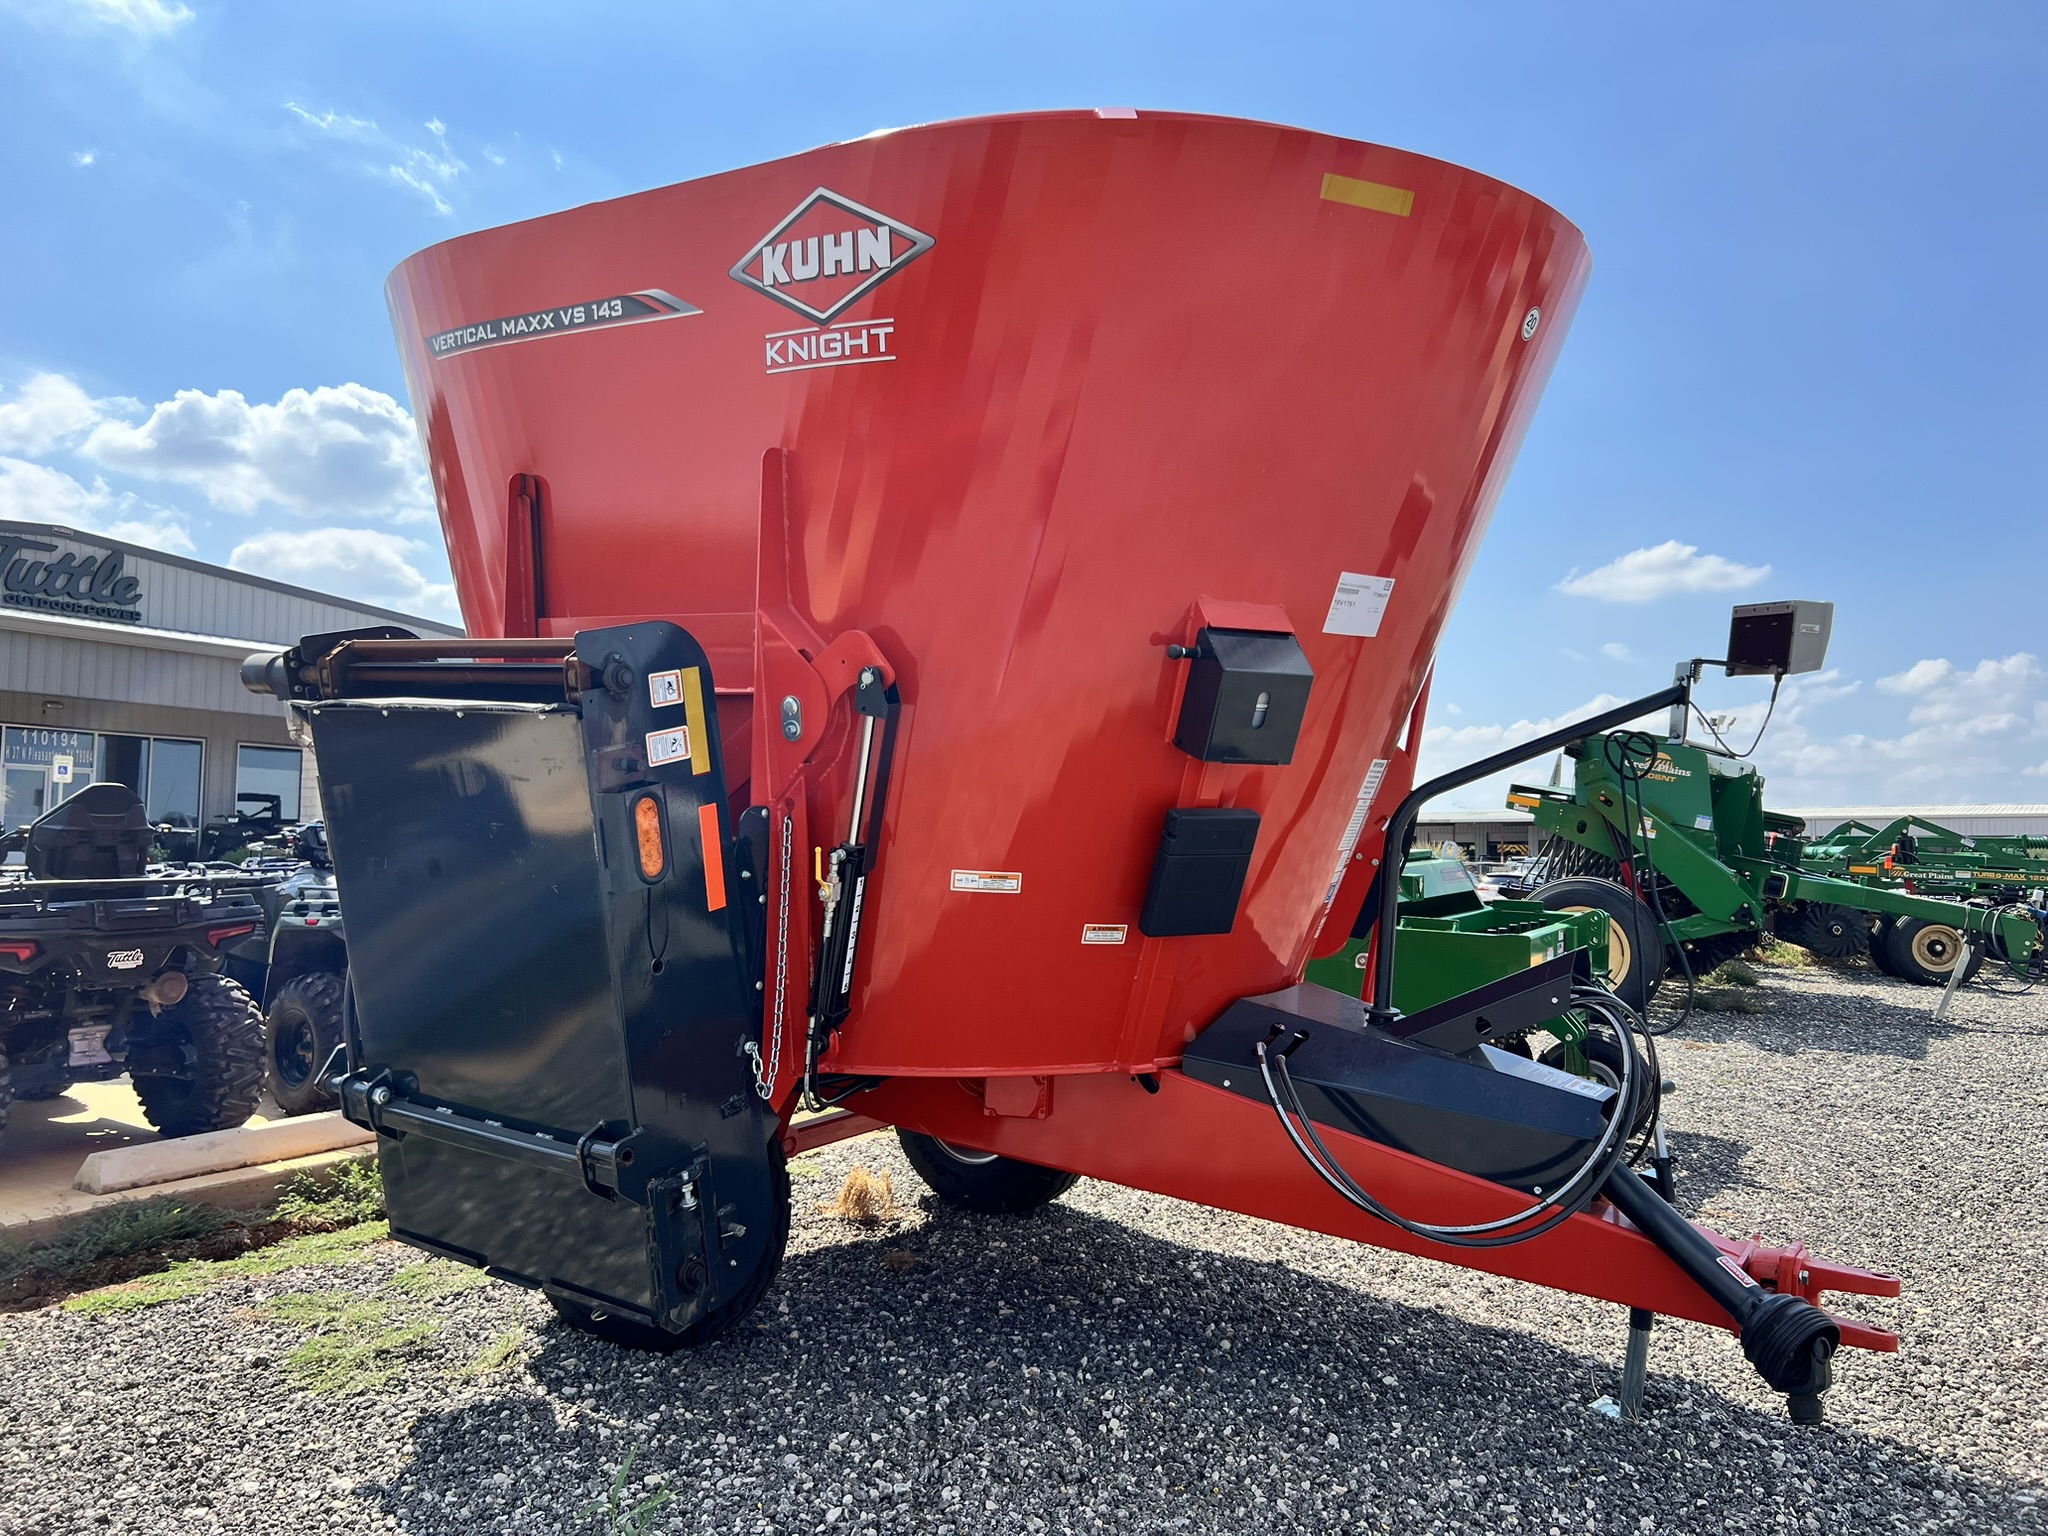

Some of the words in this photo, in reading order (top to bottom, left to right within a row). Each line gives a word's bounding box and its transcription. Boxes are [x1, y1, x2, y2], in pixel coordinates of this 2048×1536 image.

[762, 226, 892, 286] KUHN
[432, 324, 497, 352] VERTICAL
[501, 312, 555, 336] MAXX
[560, 306, 586, 326] VS
[591, 299, 623, 321] 143
[1526, 313, 1538, 330] 20
[765, 326, 894, 366] KNIGHT
[0, 535, 143, 606] Tuttle
[4, 593, 85, 614] OUTDOOR
[85, 604, 142, 621] POWER
[21, 728, 78, 748] 110194
[1636, 770, 1677, 782] 106NT
[1657, 763, 1692, 777] Plains
[1928, 872, 1954, 880] Plains
[107, 949, 144, 967] Tuttle
